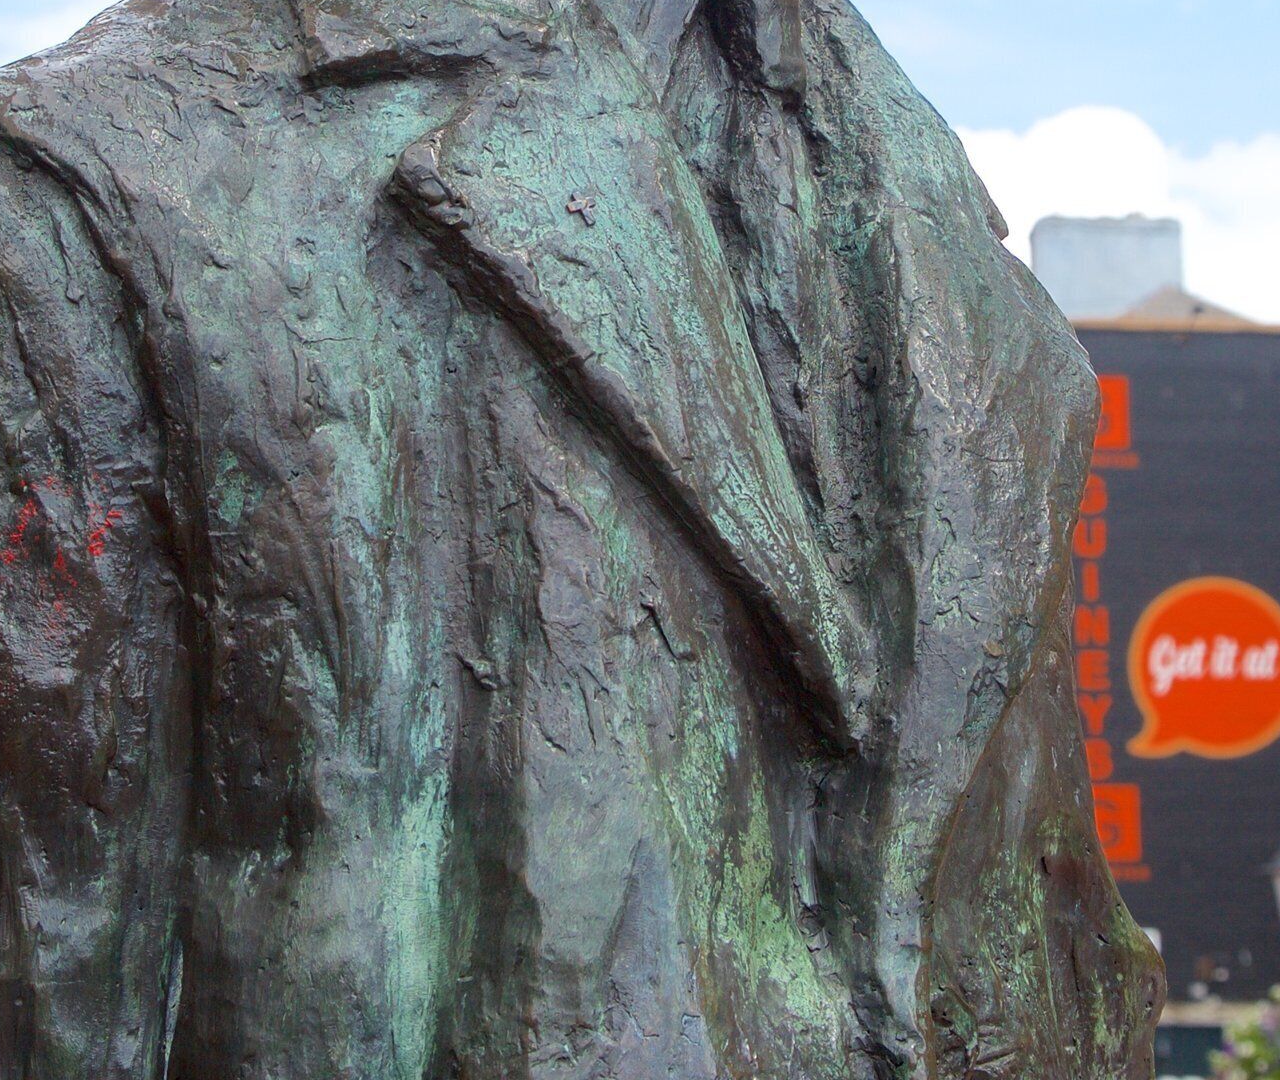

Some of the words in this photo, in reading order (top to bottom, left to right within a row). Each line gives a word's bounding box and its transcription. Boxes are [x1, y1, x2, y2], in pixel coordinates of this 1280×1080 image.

[1148, 633, 1207, 697] Get
[1210, 634, 1239, 680] it
[1242, 638, 1280, 681] at
